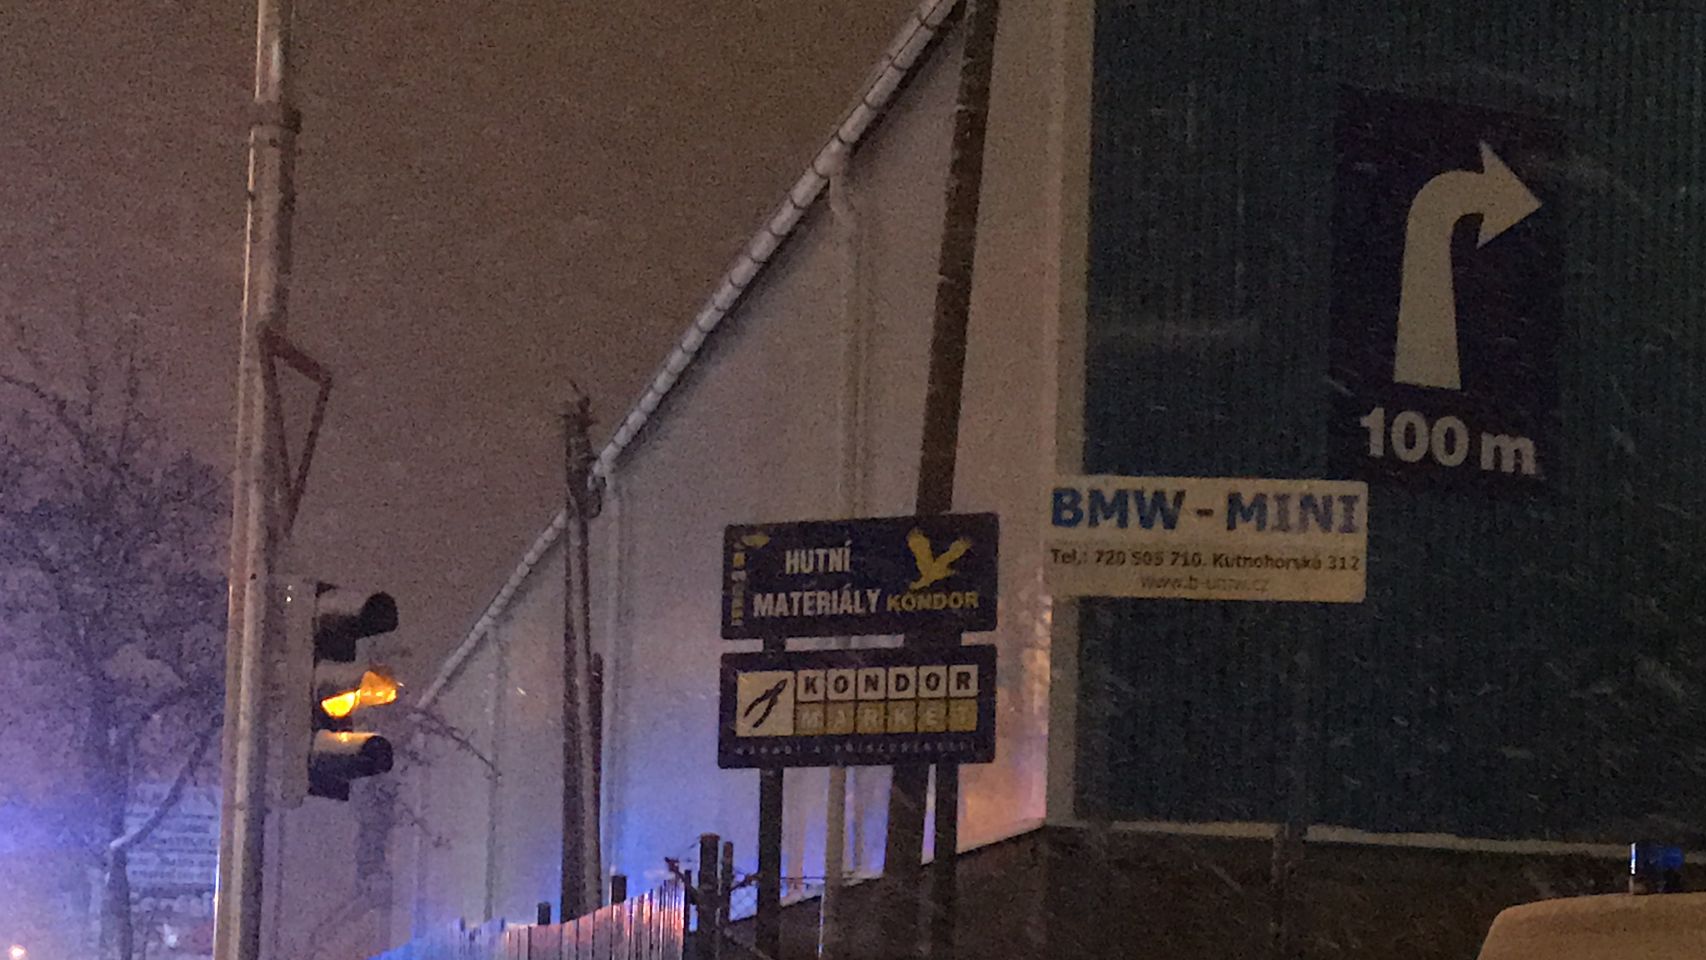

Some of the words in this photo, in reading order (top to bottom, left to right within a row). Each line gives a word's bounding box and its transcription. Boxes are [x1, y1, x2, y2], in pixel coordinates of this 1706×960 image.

[1360, 406, 1470, 468] 100
[1480, 431, 1537, 475] m
[785, 540, 853, 575] HUTNÍ
[752, 583, 882, 618] MATERIÁLY
[886, 590, 980, 613] KONDOR
[803, 670, 972, 695] KONDOR
[802, 707, 968, 729] MARKET
